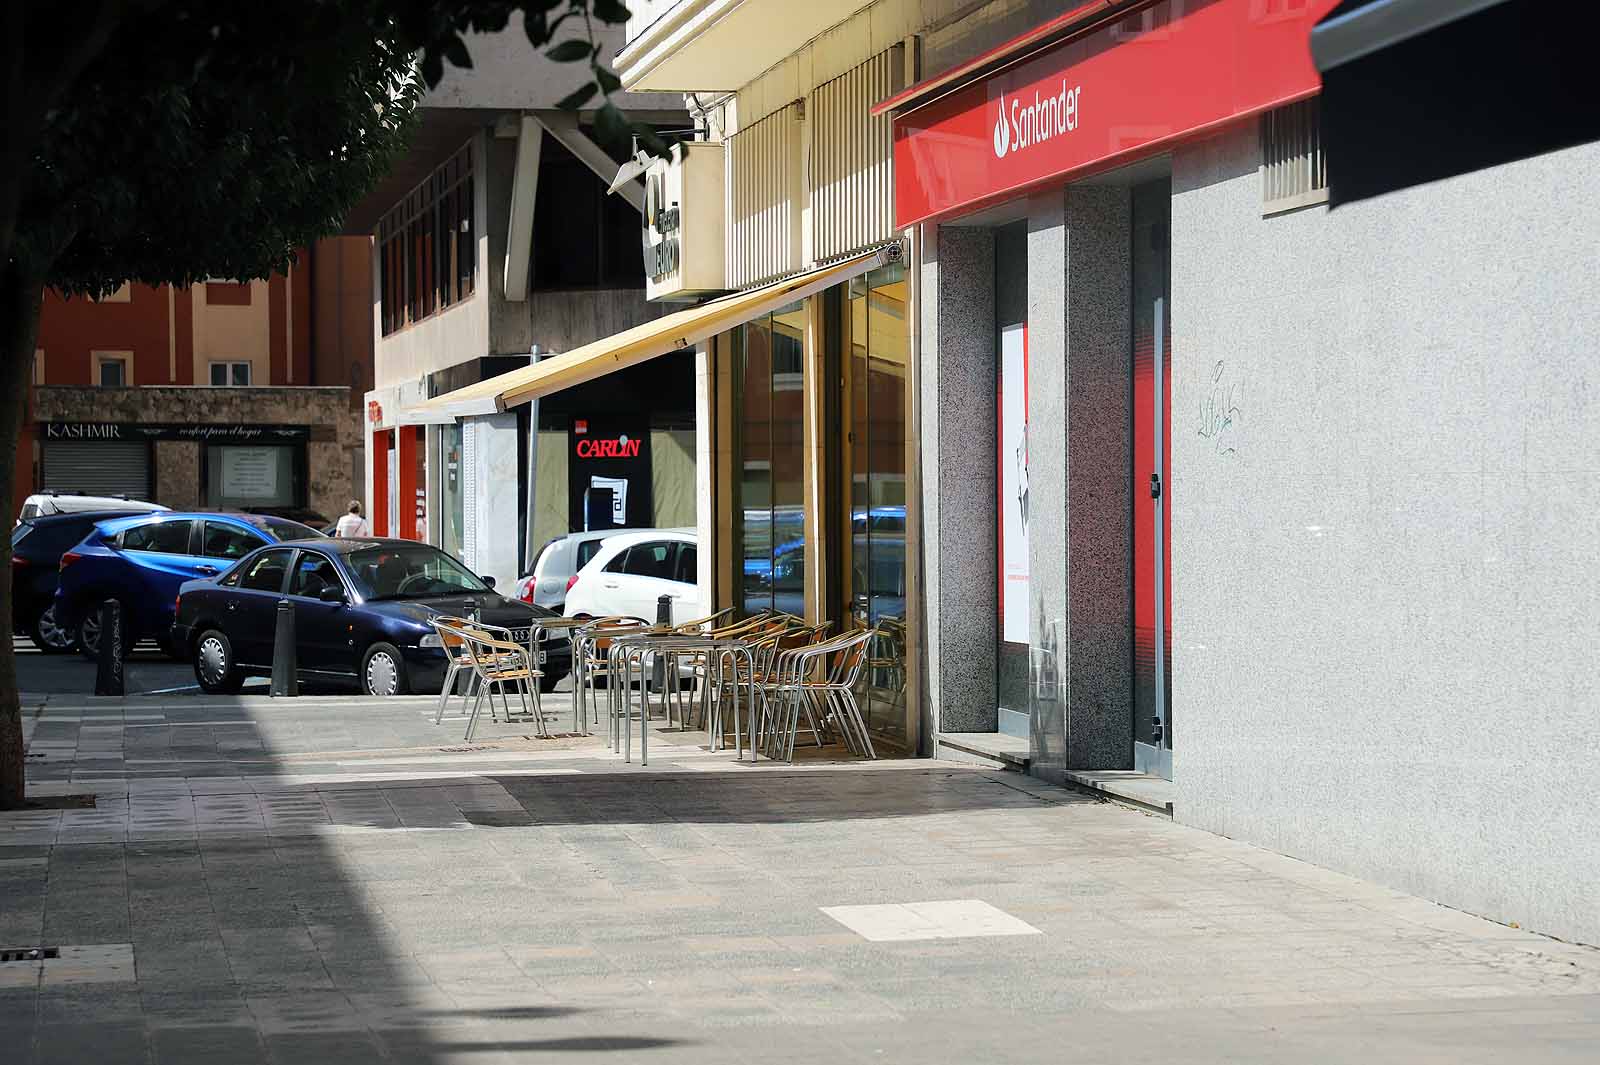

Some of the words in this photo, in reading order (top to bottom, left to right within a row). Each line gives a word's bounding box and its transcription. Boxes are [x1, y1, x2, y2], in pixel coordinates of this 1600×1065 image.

[1011, 78, 1081, 152] Santander
[47, 423, 121, 439] KASHMIR
[576, 434, 641, 458] CARLIN
